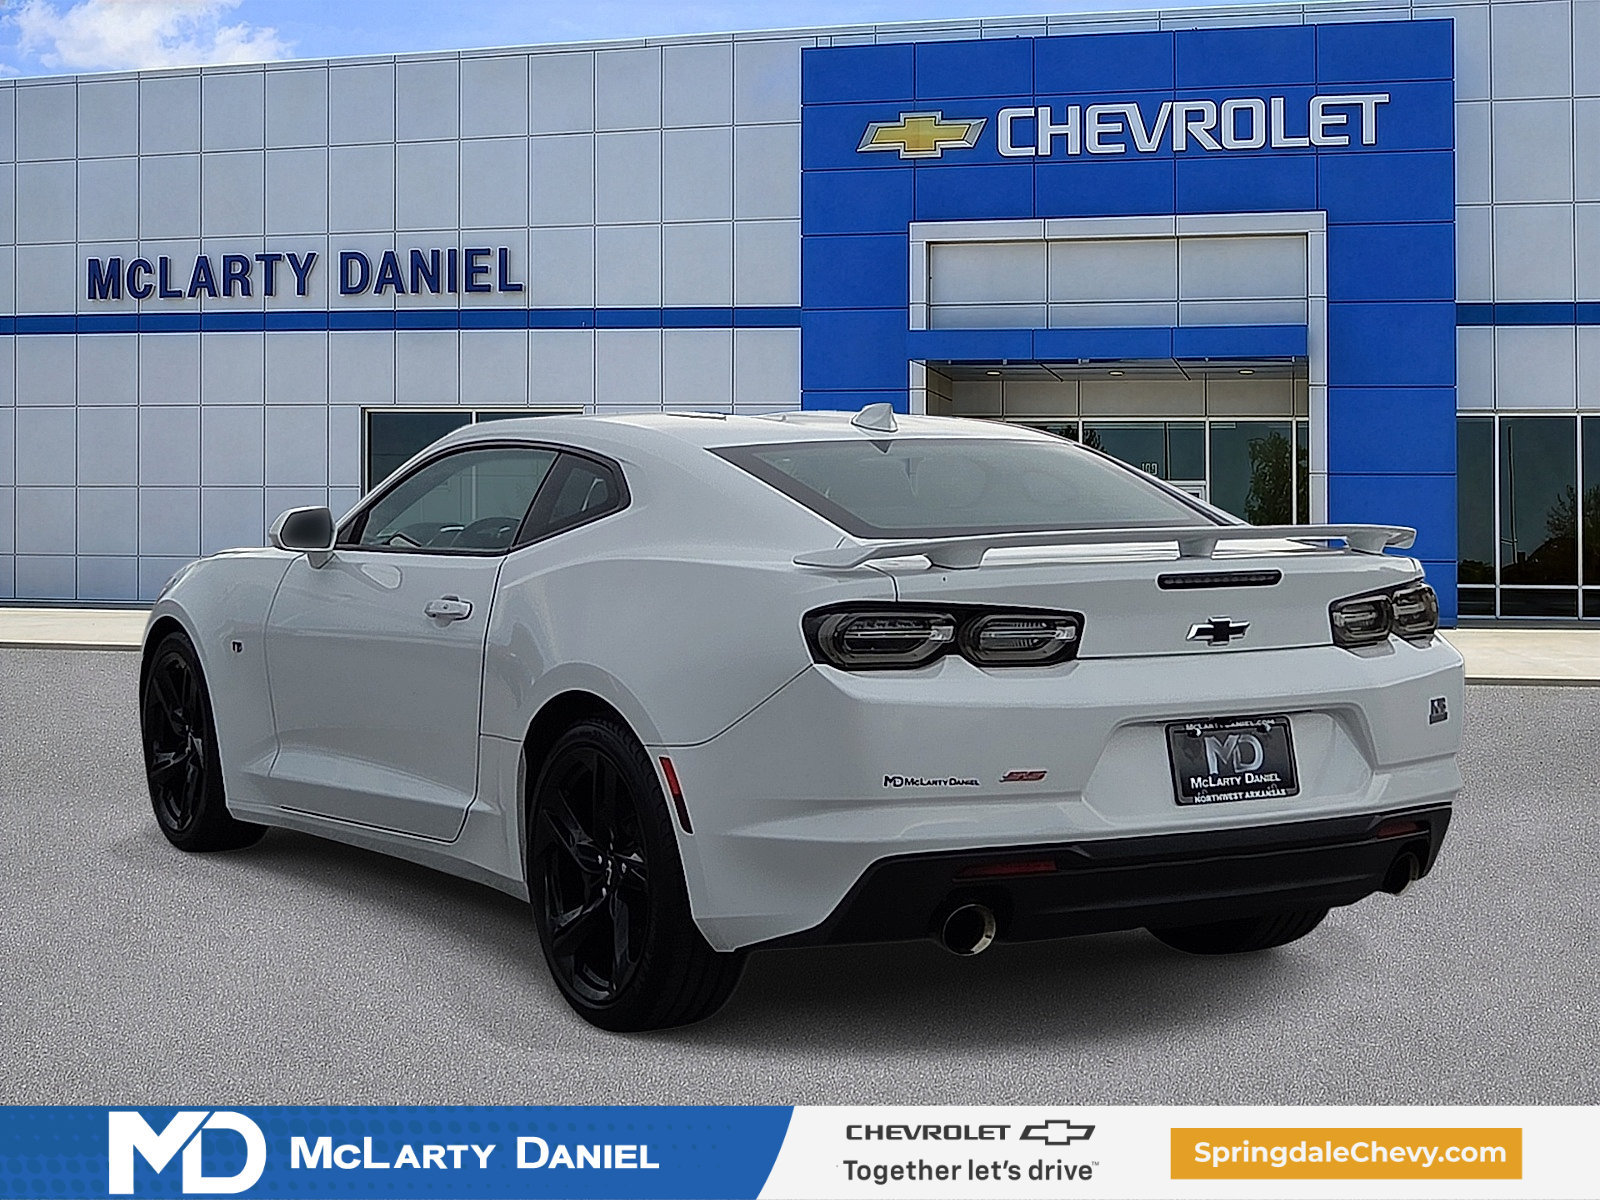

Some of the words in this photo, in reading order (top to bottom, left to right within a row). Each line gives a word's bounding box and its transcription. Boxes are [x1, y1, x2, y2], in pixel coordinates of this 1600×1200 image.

[997, 93, 1390, 157] CHEVROLET
[87, 252, 319, 300] MCLARTY
[339, 247, 524, 296] DANIEL
[1204, 734, 1264, 774] MD
[1194, 791, 1245, 803] NORTHWEST
[1245, 788, 1287, 799] ARKANSAS
